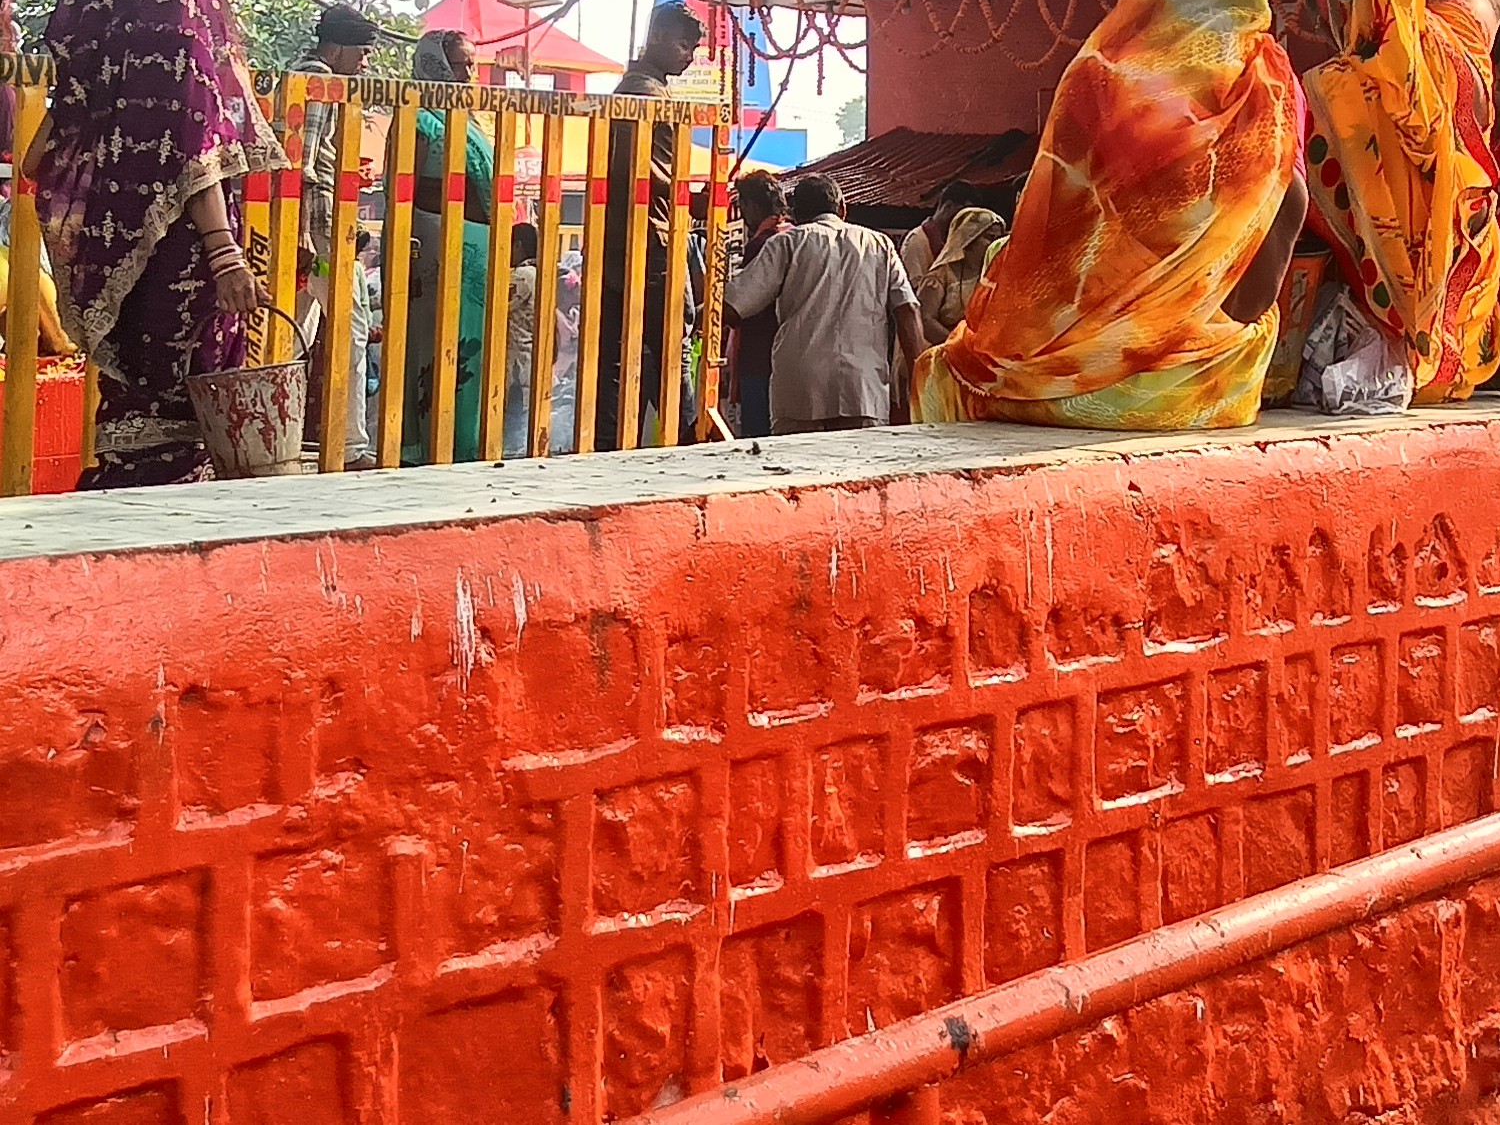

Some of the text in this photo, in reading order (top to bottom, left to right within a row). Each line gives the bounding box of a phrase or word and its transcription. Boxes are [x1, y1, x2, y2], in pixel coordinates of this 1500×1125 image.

[347, 77, 411, 105] PUBLIC
[419, 82, 474, 110] WORKS
[583, 93, 648, 122] VISION
[655, 99, 692, 125] REWA
